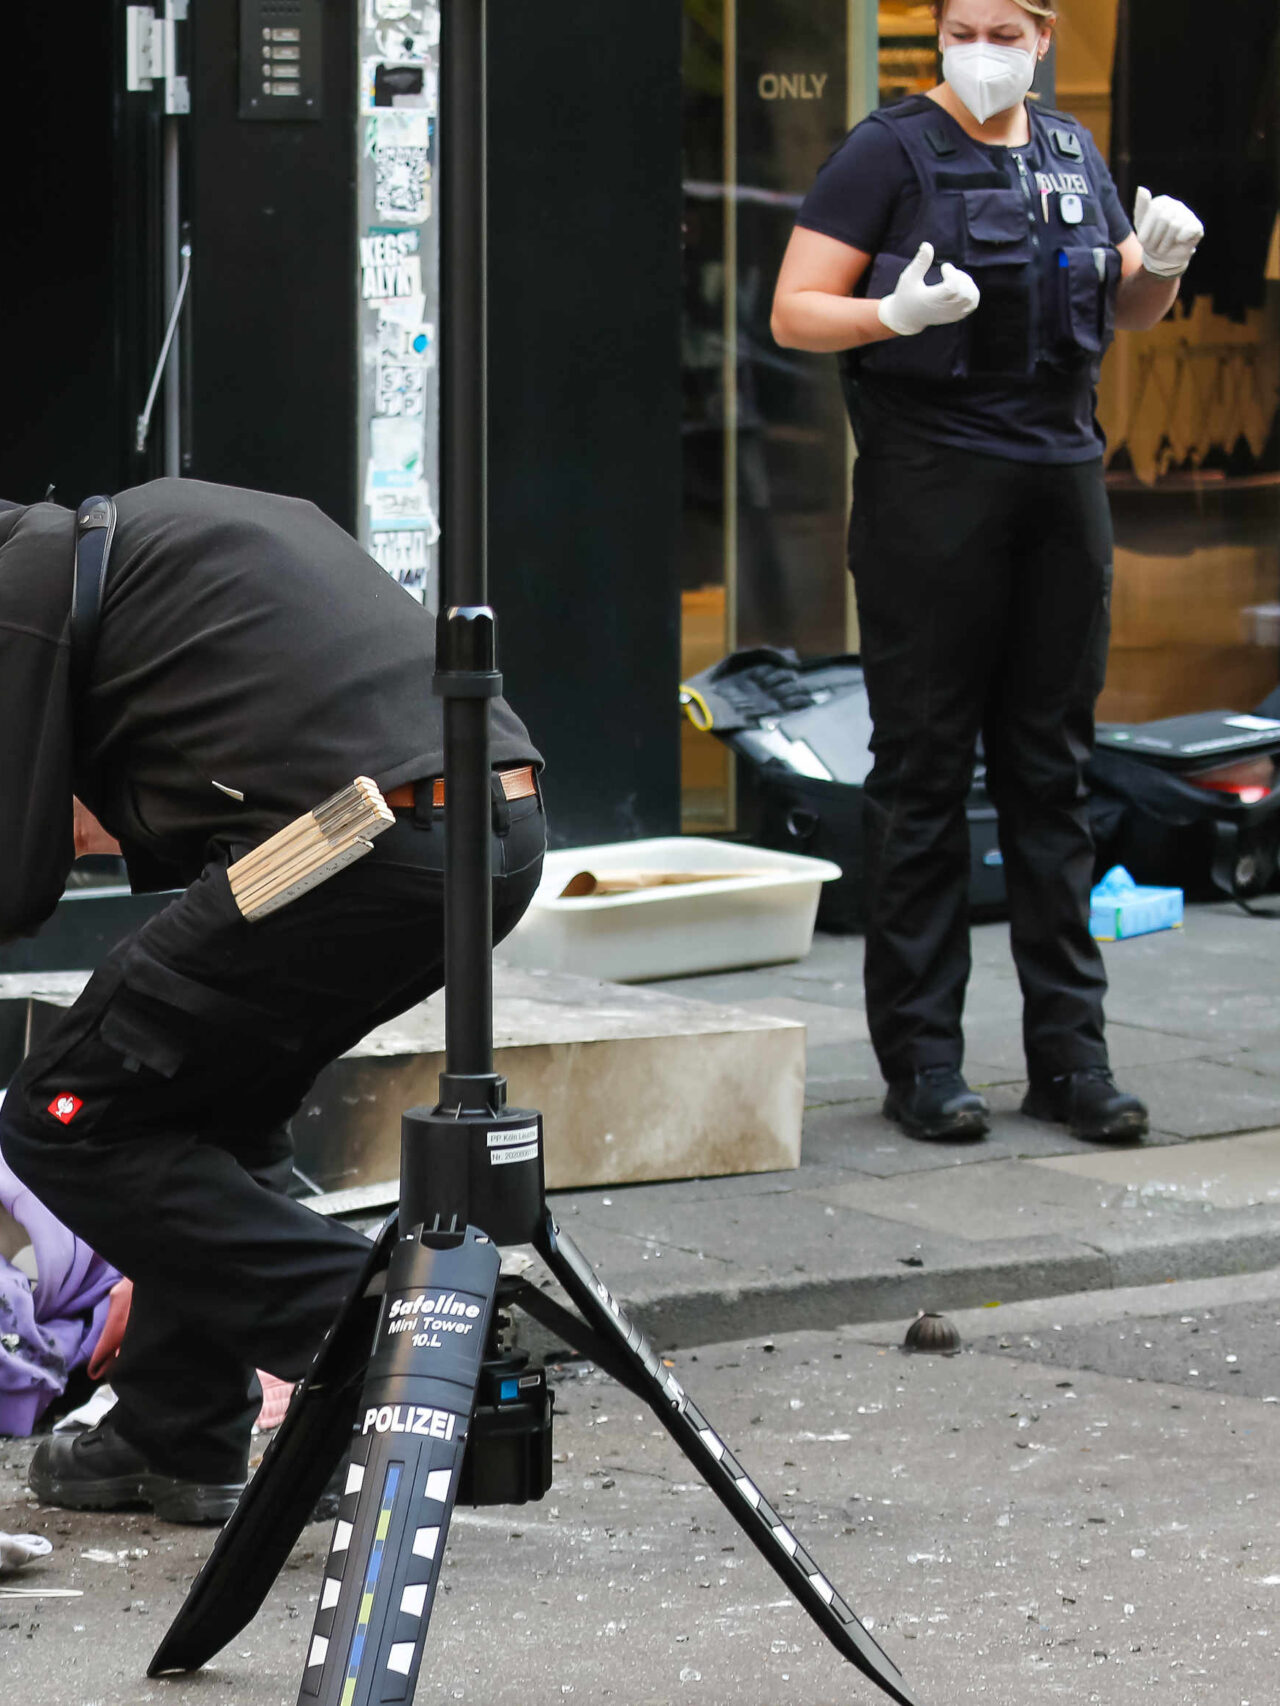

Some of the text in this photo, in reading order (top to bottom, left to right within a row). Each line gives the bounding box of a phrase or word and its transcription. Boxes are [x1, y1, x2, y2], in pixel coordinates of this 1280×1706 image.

[758, 73, 828, 99] ONLY
[388, 1317, 472, 1335] Mini Tower
[362, 1405, 456, 1441] POLIZEI
